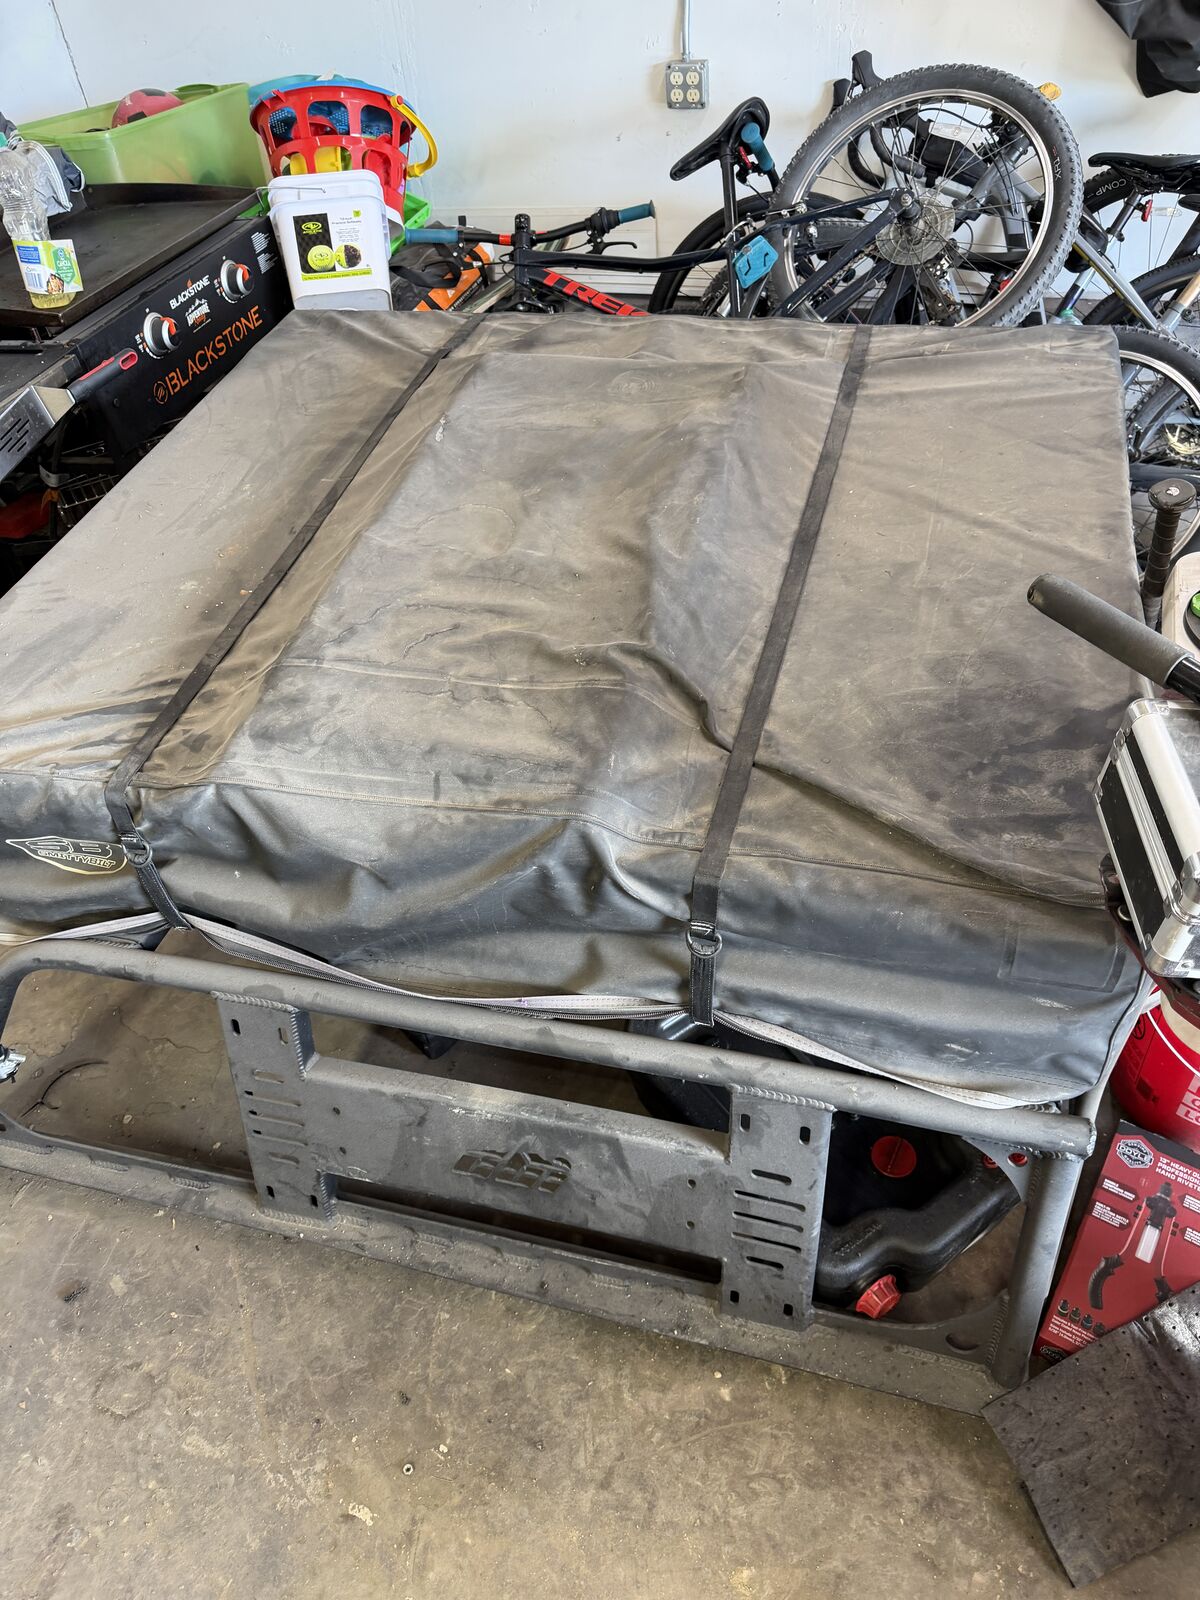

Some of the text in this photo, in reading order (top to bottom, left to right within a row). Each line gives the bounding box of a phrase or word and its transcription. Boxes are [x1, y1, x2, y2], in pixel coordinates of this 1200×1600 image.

[1095, 178, 1127, 196] COMP
[169, 275, 211, 310] BLACKSTONE
[165, 305, 263, 396] BLACKSTONE
[37, 849, 117, 869] SMITTYBILT
[1120, 1145, 1150, 1161] DOYLE
[1155, 1167, 1176, 1181] HAND
[1157, 1161, 1200, 1186] PROFESSION
[1170, 1161, 1193, 1175] HEAVY
